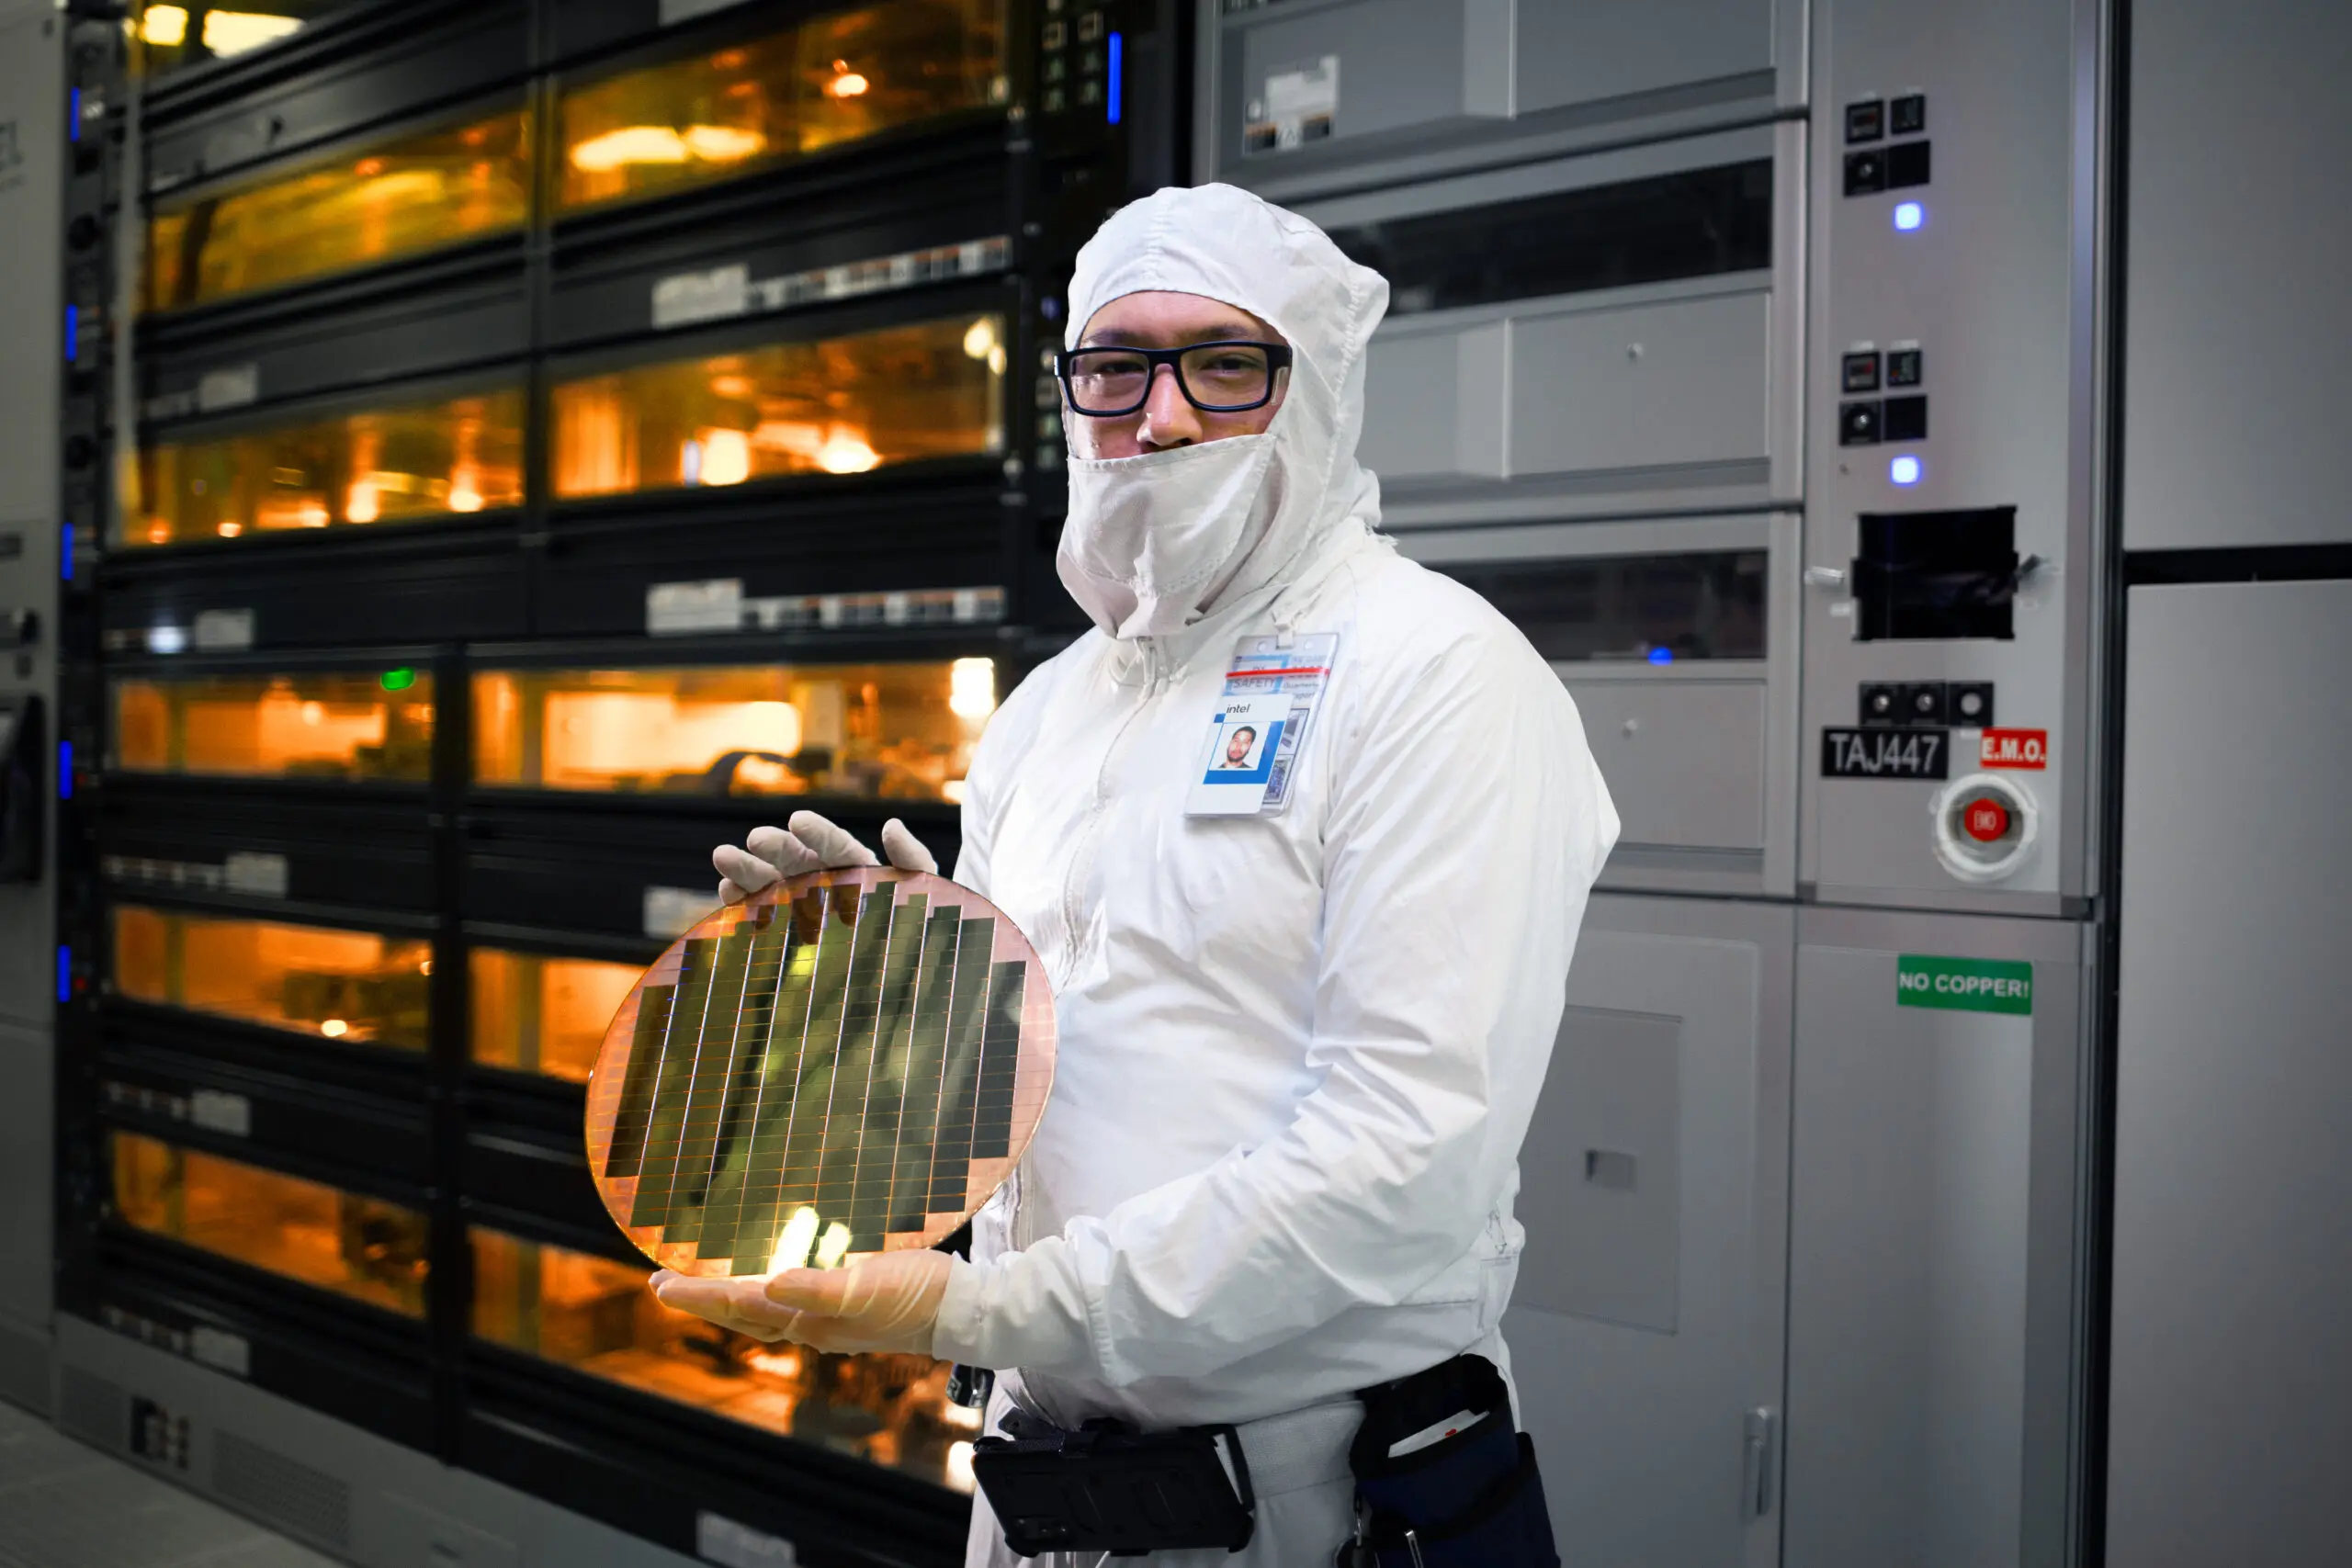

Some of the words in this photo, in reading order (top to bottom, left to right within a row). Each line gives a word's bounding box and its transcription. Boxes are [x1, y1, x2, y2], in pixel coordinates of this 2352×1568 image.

[1226, 704, 1251, 714] intel
[1828, 732, 1940, 773] TAJ447
[1981, 736, 2047, 762] E.M.O.
[1899, 971, 1930, 991] NO
[1935, 974, 2030, 998] COPPER!
